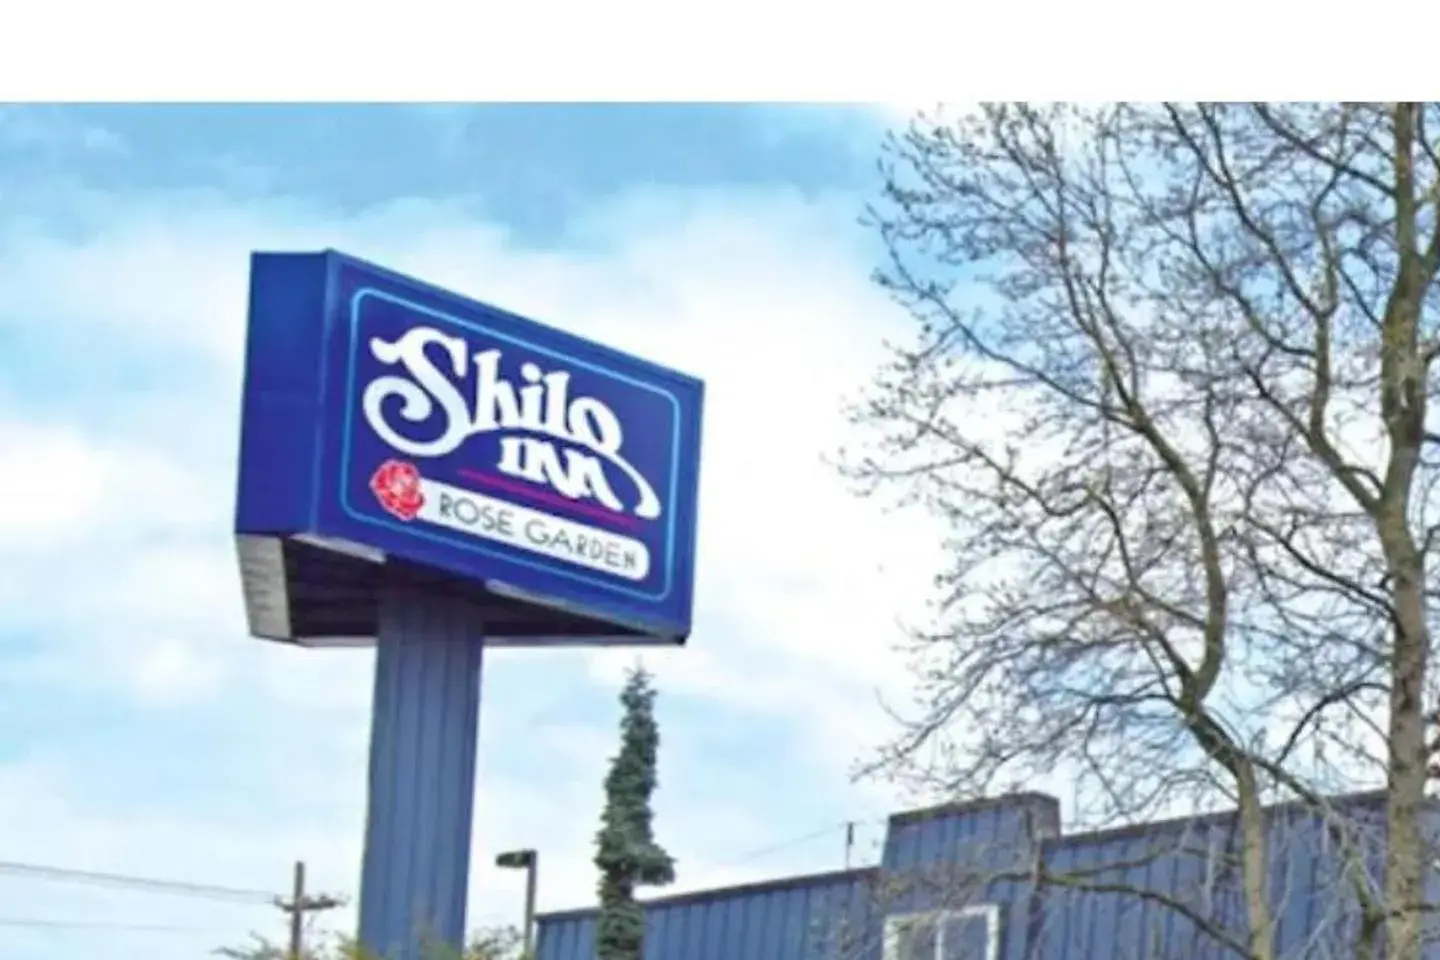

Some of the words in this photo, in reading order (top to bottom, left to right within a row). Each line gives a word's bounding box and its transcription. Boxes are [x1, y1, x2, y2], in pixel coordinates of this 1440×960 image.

[363, 326, 661, 519] Shilo
[497, 437, 623, 512] INN
[438, 493, 514, 536] ROSE
[525, 518, 637, 569] GARDEN
